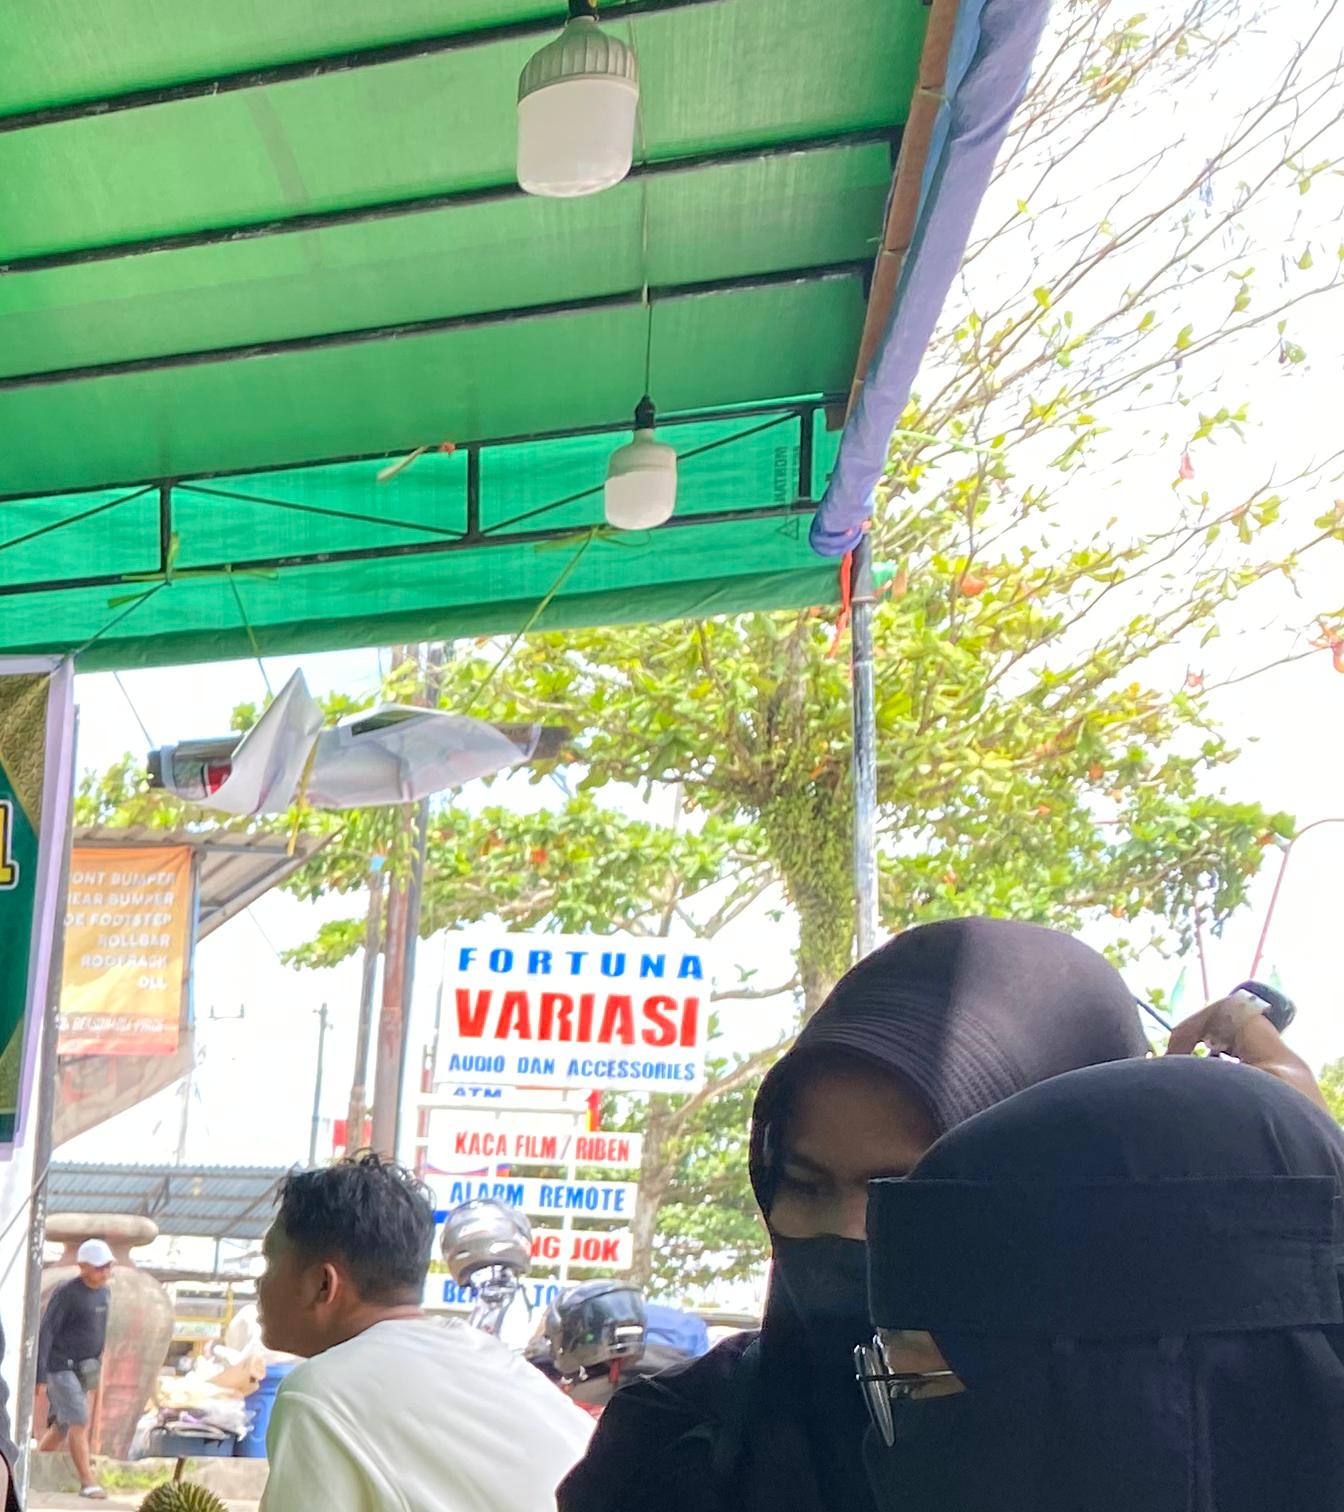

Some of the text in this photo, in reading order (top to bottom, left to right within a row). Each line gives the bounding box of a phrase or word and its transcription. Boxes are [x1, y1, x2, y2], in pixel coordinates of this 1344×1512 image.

[69, 871, 106, 885] ONT
[109, 892, 174, 905] BUMPER
[458, 947, 704, 980] FORTUNA
[454, 987, 700, 1048] VARIASI
[448, 1053, 697, 1081] AUDIO DAN ACCESSORIES
[452, 1087, 503, 1099] ATM
[454, 1130, 507, 1157] KACA
[514, 1134, 558, 1160] FILM
[575, 1137, 631, 1162] RIBEN
[538, 1184, 626, 1212] REMOTE
[569, 1236, 621, 1263] JOK
